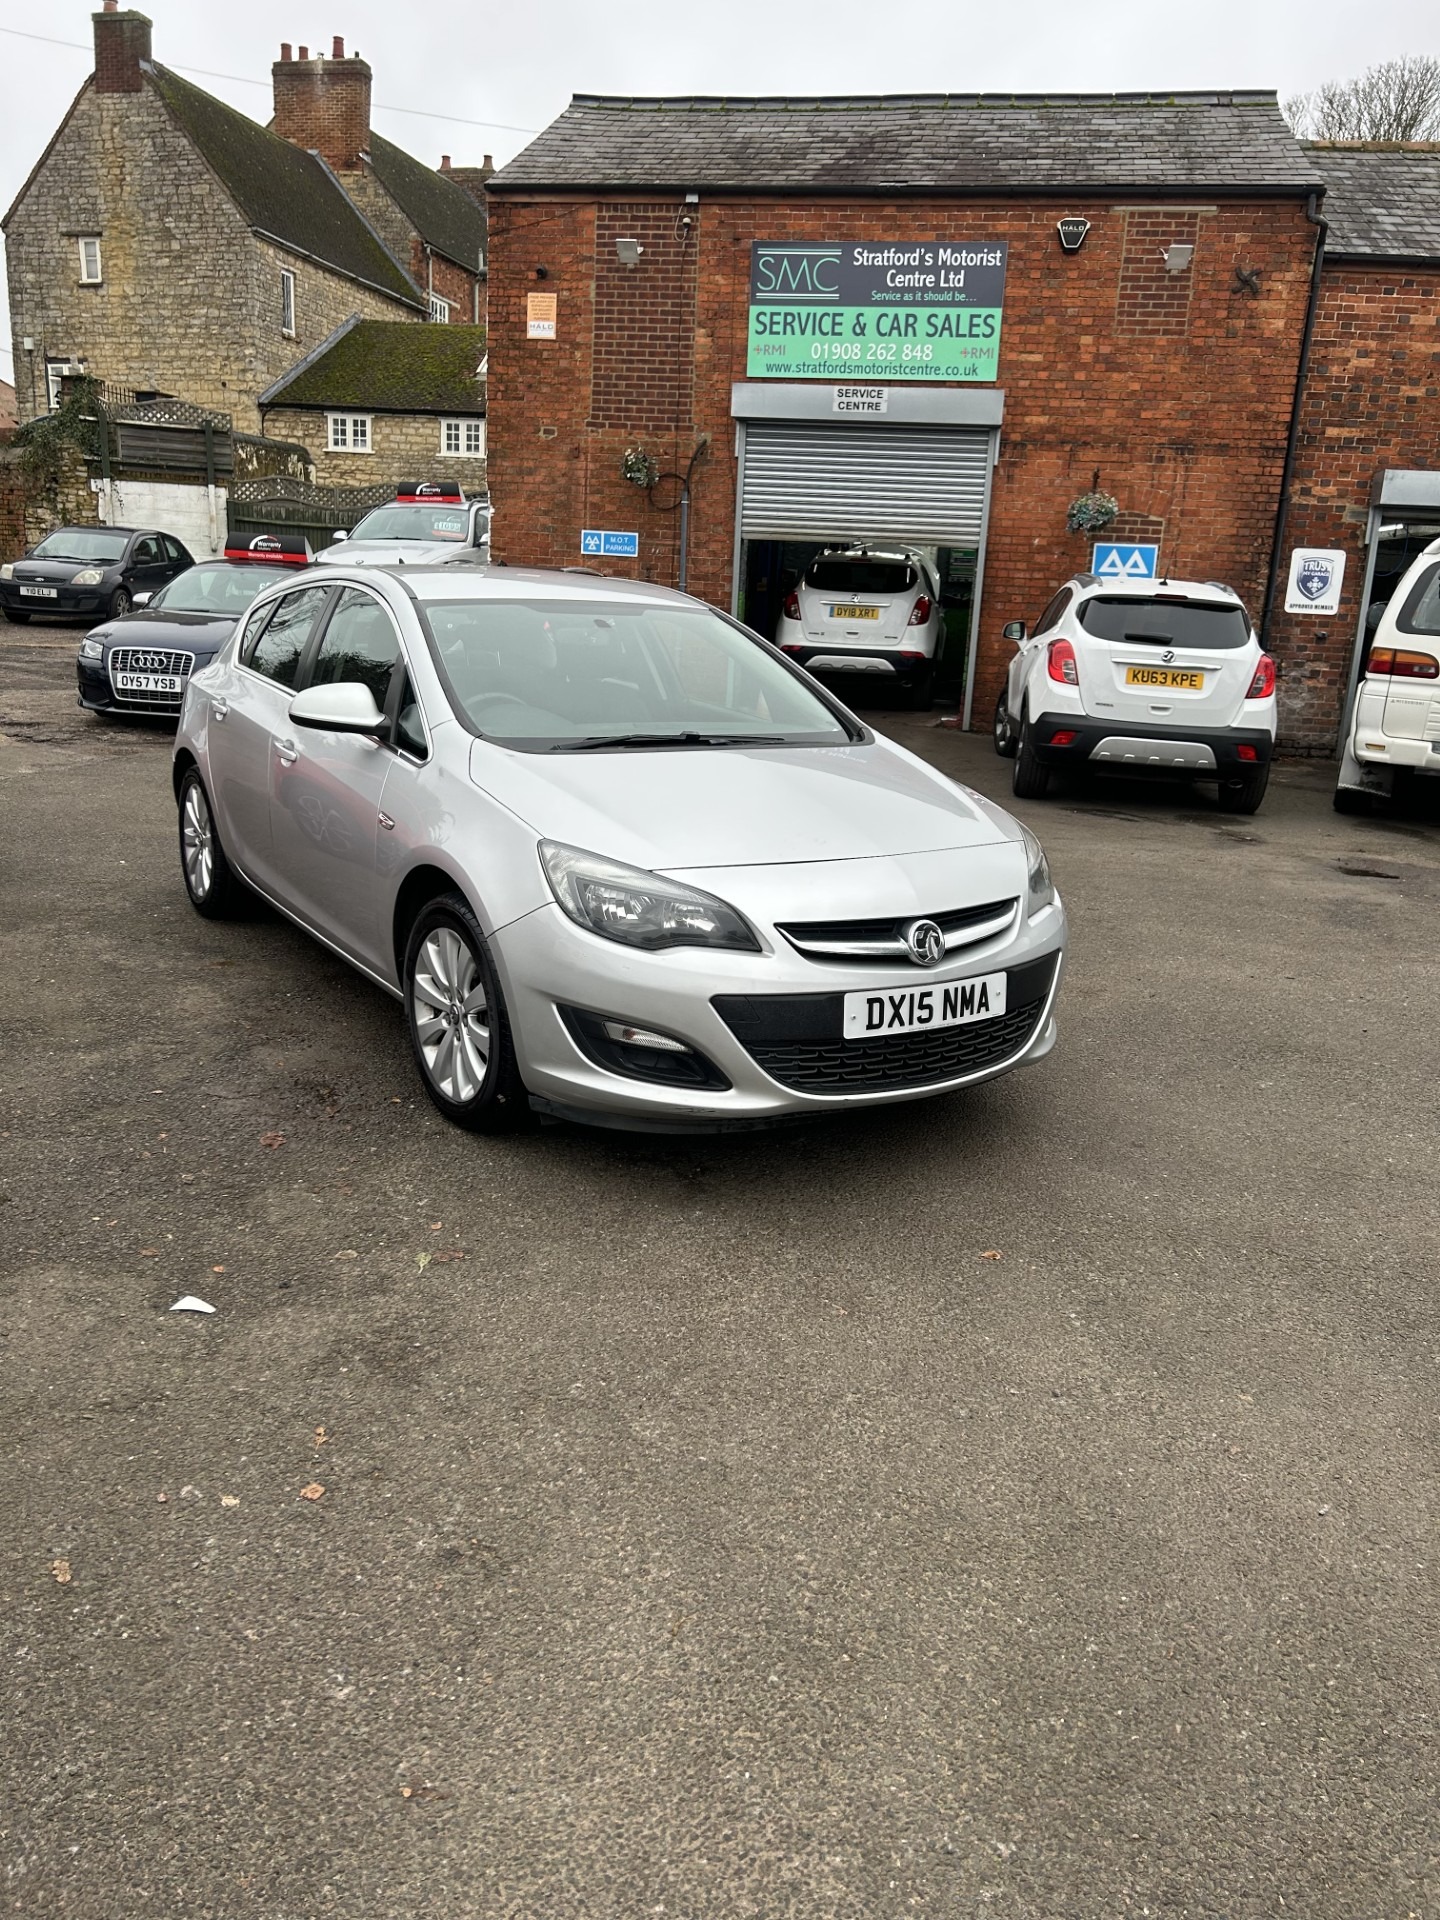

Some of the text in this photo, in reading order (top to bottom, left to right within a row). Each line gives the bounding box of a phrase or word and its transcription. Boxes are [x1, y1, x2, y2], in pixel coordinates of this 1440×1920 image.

[853, 248, 1002, 267] Stratford's Motorist
[757, 256, 841, 292] SMC
[886, 269, 964, 287] Centre Ltd
[871, 291, 977, 302] Service as it should be...
[755, 311, 995, 338] SERVICE & CAR SALES
[811, 343, 933, 361] 01908 262 848
[766, 360, 978, 376] www.stratfordsmotoristcentre.co.uk
[837, 388, 884, 399] SERVICE
[838, 401, 881, 411] CENTRE
[258, 541, 281, 549] Warranty
[605, 544, 635, 552] PARKING
[837, 607, 876, 618] DY18 XRT
[121, 675, 176, 689] OY57 YSB
[1131, 669, 1198, 687] KU63 KPE
[865, 982, 990, 1031] DX15 NMA
